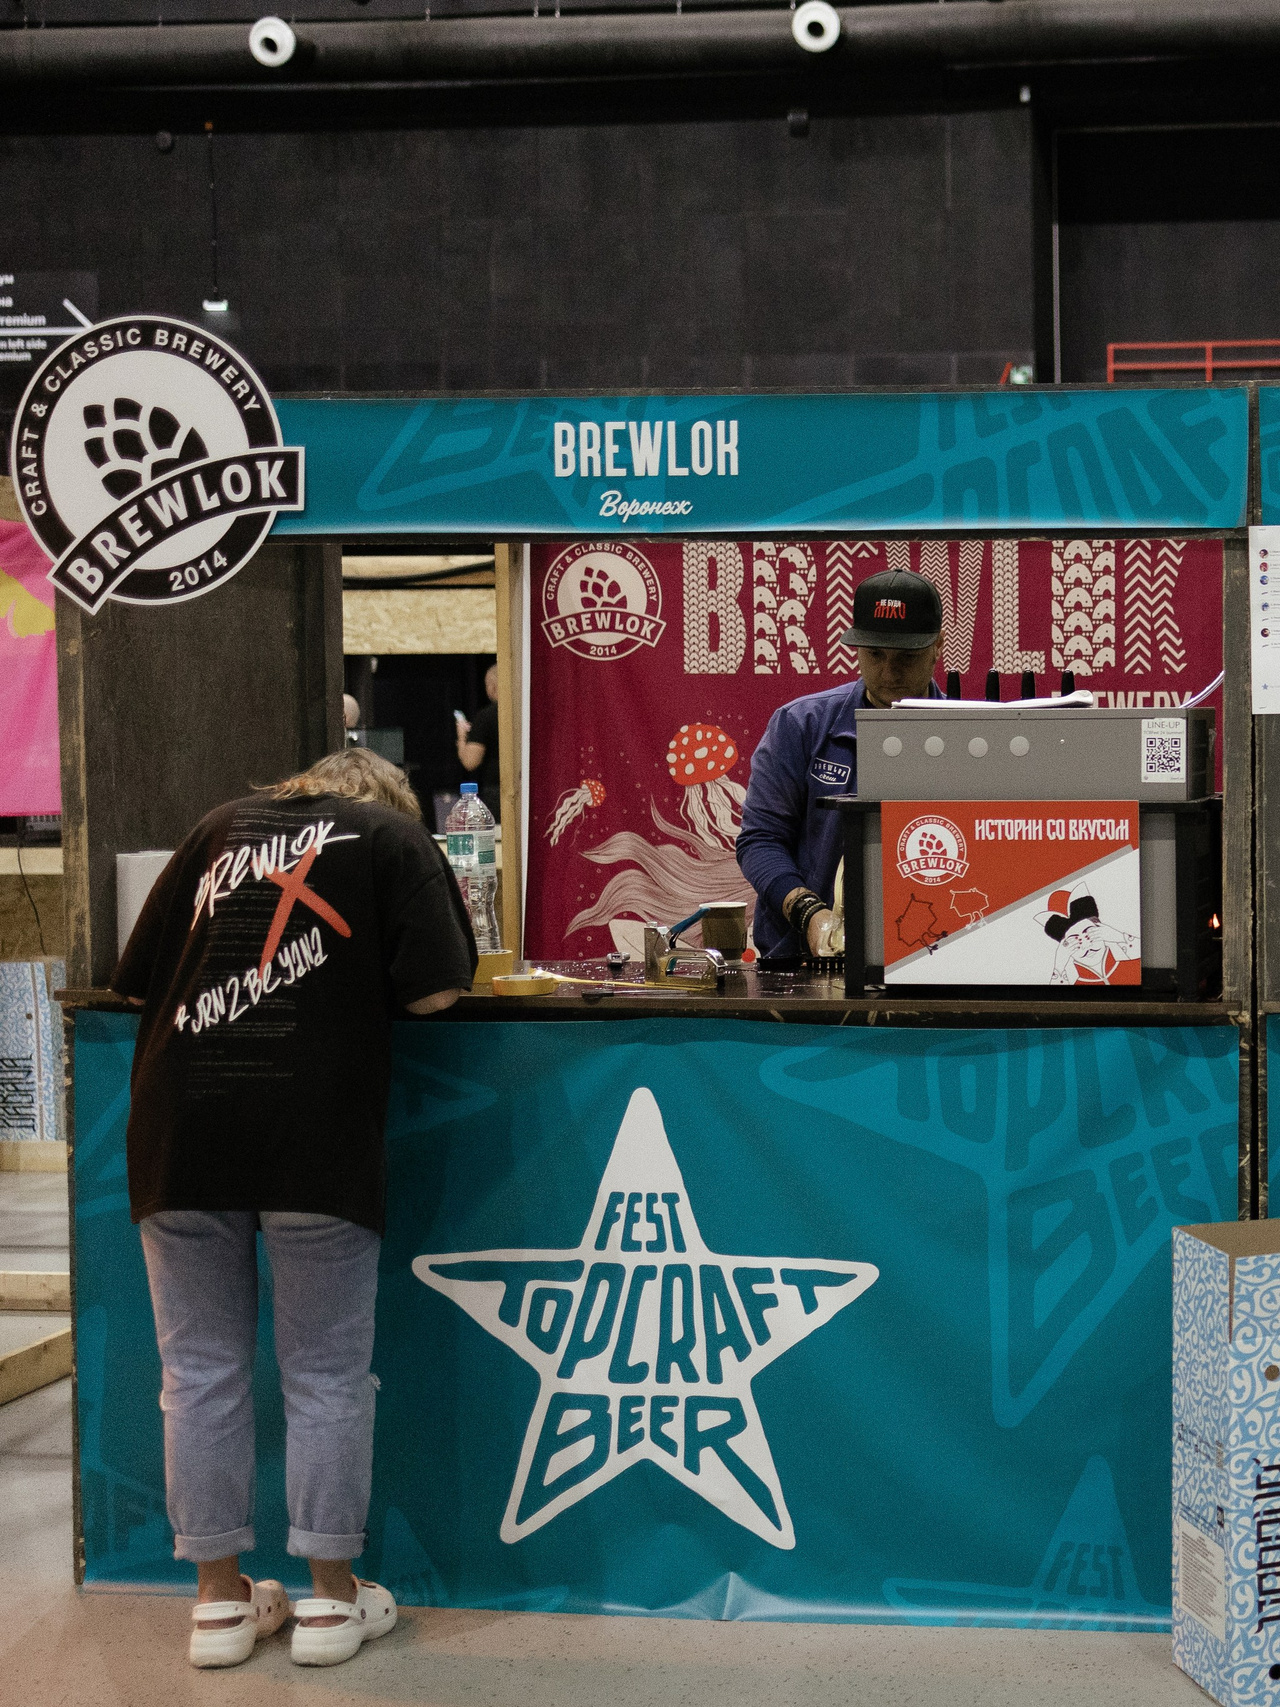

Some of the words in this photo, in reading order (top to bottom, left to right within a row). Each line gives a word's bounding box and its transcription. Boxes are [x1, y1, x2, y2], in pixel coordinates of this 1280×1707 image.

[44, 328, 142, 392] CLASSIC
[154, 329, 260, 412] BREWERY
[31, 403, 48, 417] &
[21, 428, 48, 516] CRAFT
[554, 420, 739, 477] BREWLOK
[66, 460, 287, 595] BREWLOK
[599, 490, 693, 523] Воронеж
[169, 550, 228, 592] 2014
[546, 564, 565, 600] CRAFT
[575, 543, 622, 556] CLASSIC
[626, 551, 657, 602] BREWERY
[550, 612, 656, 640] BREWLOK
[589, 645, 617, 656] 2014
[1147, 721, 1180, 729] LINE-UP
[900, 830, 910, 851] CRAFT
[916, 818, 944, 826] CLASSIC
[945, 823, 964, 852] BREWERY
[974, 819, 1043, 841] ИСТОРИИ
[1046, 819, 1065, 840] СО
[1069, 819, 1130, 840] ВКУСОМ
[190, 820, 361, 931] BREWLOK
[902, 858, 963, 874] BREWLOK
[594, 1191, 687, 1253] FEST
[428, 1259, 859, 1385] TOPCRAFT
[515, 1391, 783, 1532] BEER
[1043, 1540, 1123, 1599] FEST
